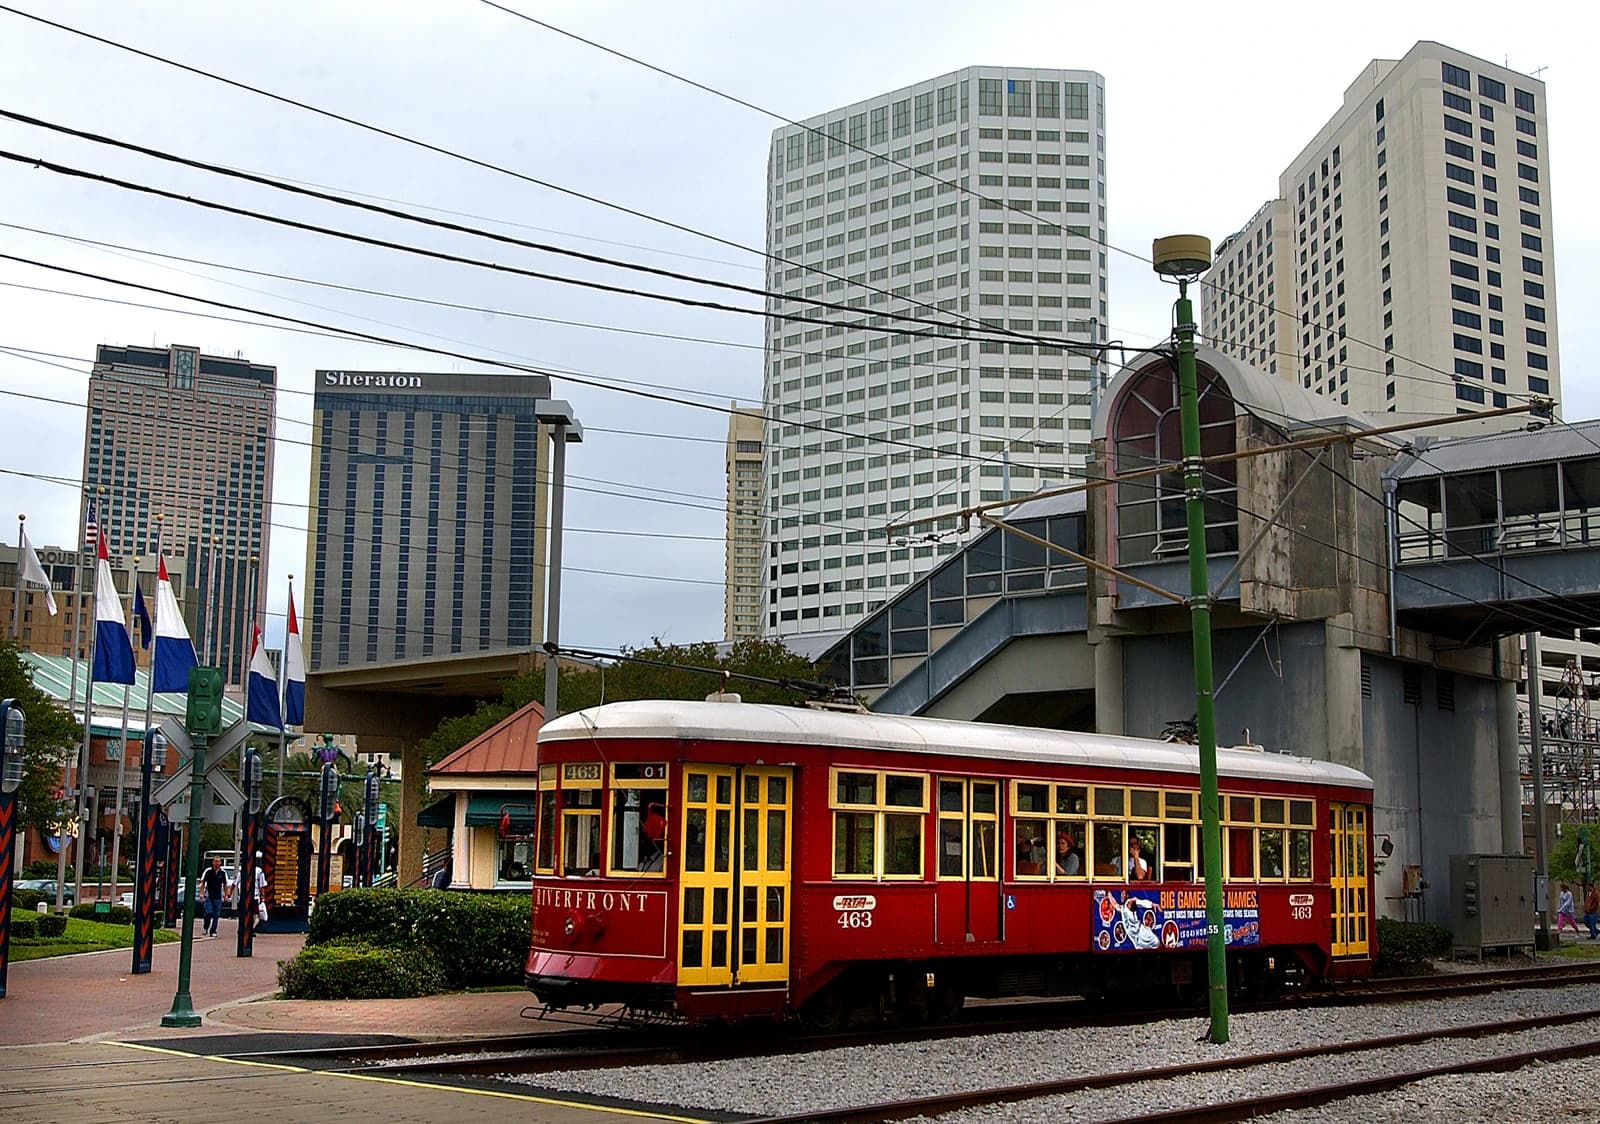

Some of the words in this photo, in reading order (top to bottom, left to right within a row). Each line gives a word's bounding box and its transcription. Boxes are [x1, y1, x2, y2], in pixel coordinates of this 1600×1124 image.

[325, 370, 422, 388] Sheraton
[36, 551, 123, 568] DOUBLEEE
[566, 765, 599, 779] 463
[536, 888, 648, 912] RIVERFRONT
[1160, 891, 1175, 909] BIG
[1227, 891, 1259, 909] NAMES.
[837, 911, 872, 929] 463
[1291, 906, 1312, 920] 463
